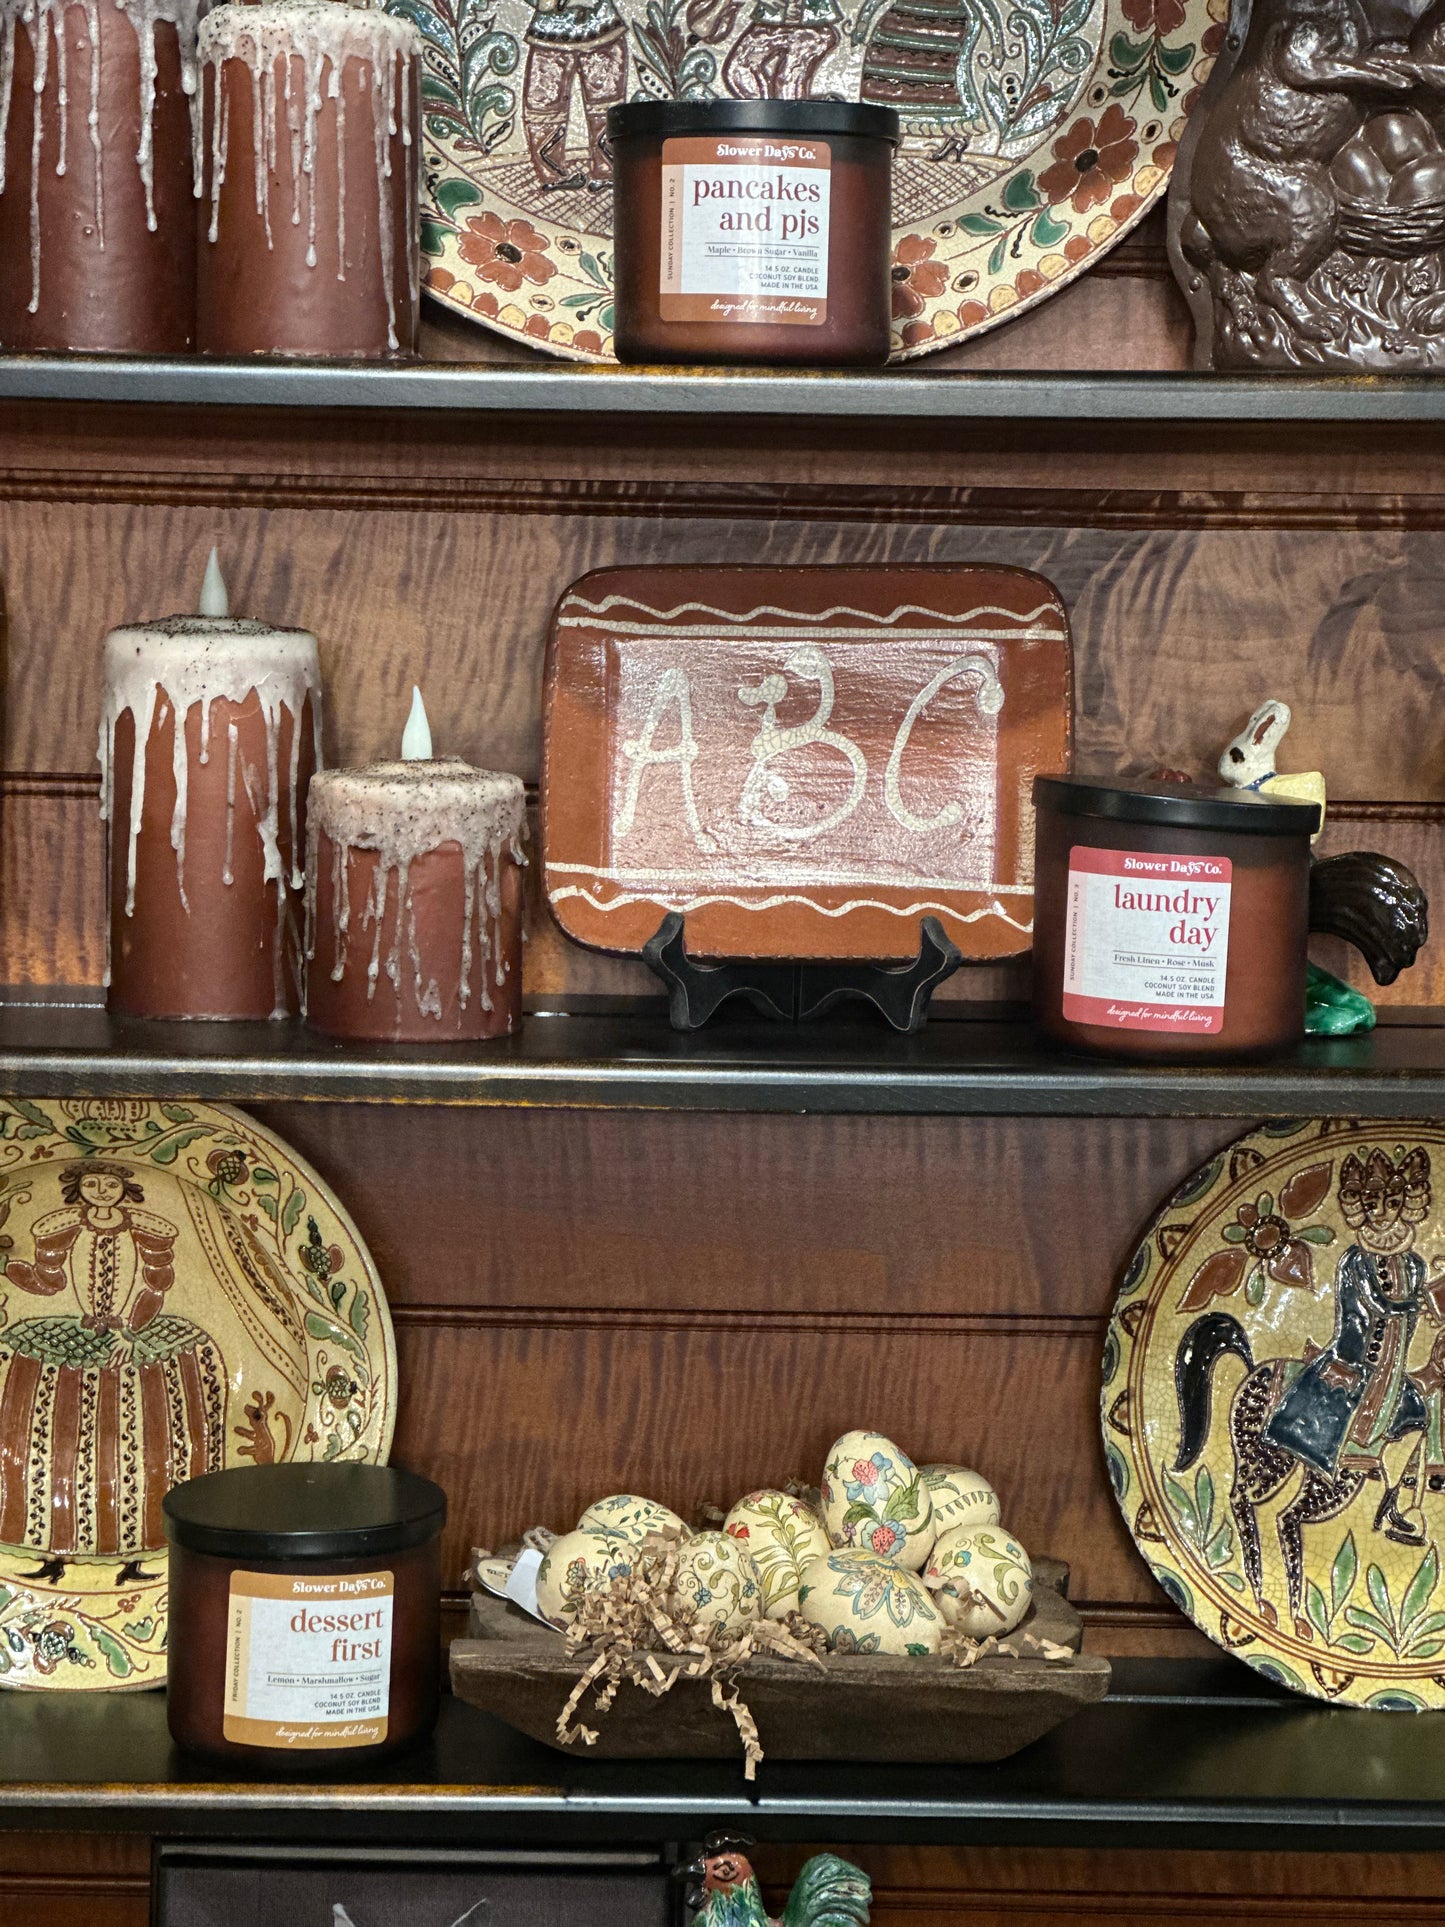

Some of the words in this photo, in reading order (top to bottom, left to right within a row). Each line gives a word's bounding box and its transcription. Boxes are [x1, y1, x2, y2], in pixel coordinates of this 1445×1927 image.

[716, 144, 762, 157] Slower
[764, 145, 799, 160] Days
[692, 174, 820, 206] pancakes
[720, 206, 773, 231] and
[782, 210, 820, 240] pjs
[708, 246, 731, 255] Maple
[737, 247, 762, 255] Brown
[765, 248, 787, 257] Sugar
[793, 248, 818, 258] Vanilla
[793, 266, 818, 274] CANDLE
[710, 299, 746, 316] designed
[746, 300, 759, 313] for
[759, 301, 794, 314] mindful
[794, 302, 818, 320] living
[612, 646, 1005, 852] ABC
[1124, 857, 1168, 871] Slower
[1170, 861, 1204, 876] Days
[1114, 884, 1221, 921] laundry
[1169, 920, 1219, 951] day
[1114, 954, 1136, 963] Fresh
[1138, 956, 1160, 965] Linen
[1106, 1005, 1141, 1022] designed
[1141, 1008, 1152, 1019] for
[1154, 1009, 1188, 1022] mindful
[1188, 1011, 1212, 1027] living
[292, 1581, 337, 1593] Slower
[339, 1579, 370, 1595] Days
[290, 1608, 384, 1633] dessert
[328, 1638, 382, 1662] first
[268, 1675, 295, 1684] Lemon
[301, 1676, 353, 1685] Marshmallow
[360, 1673, 380, 1683] Sugar
[358, 1689, 381, 1698] CANDLE
[276, 1726, 312, 1743] designed
[312, 1727, 323, 1739] for
[324, 1725, 358, 1738] mindful
[358, 1724, 379, 1739] living
